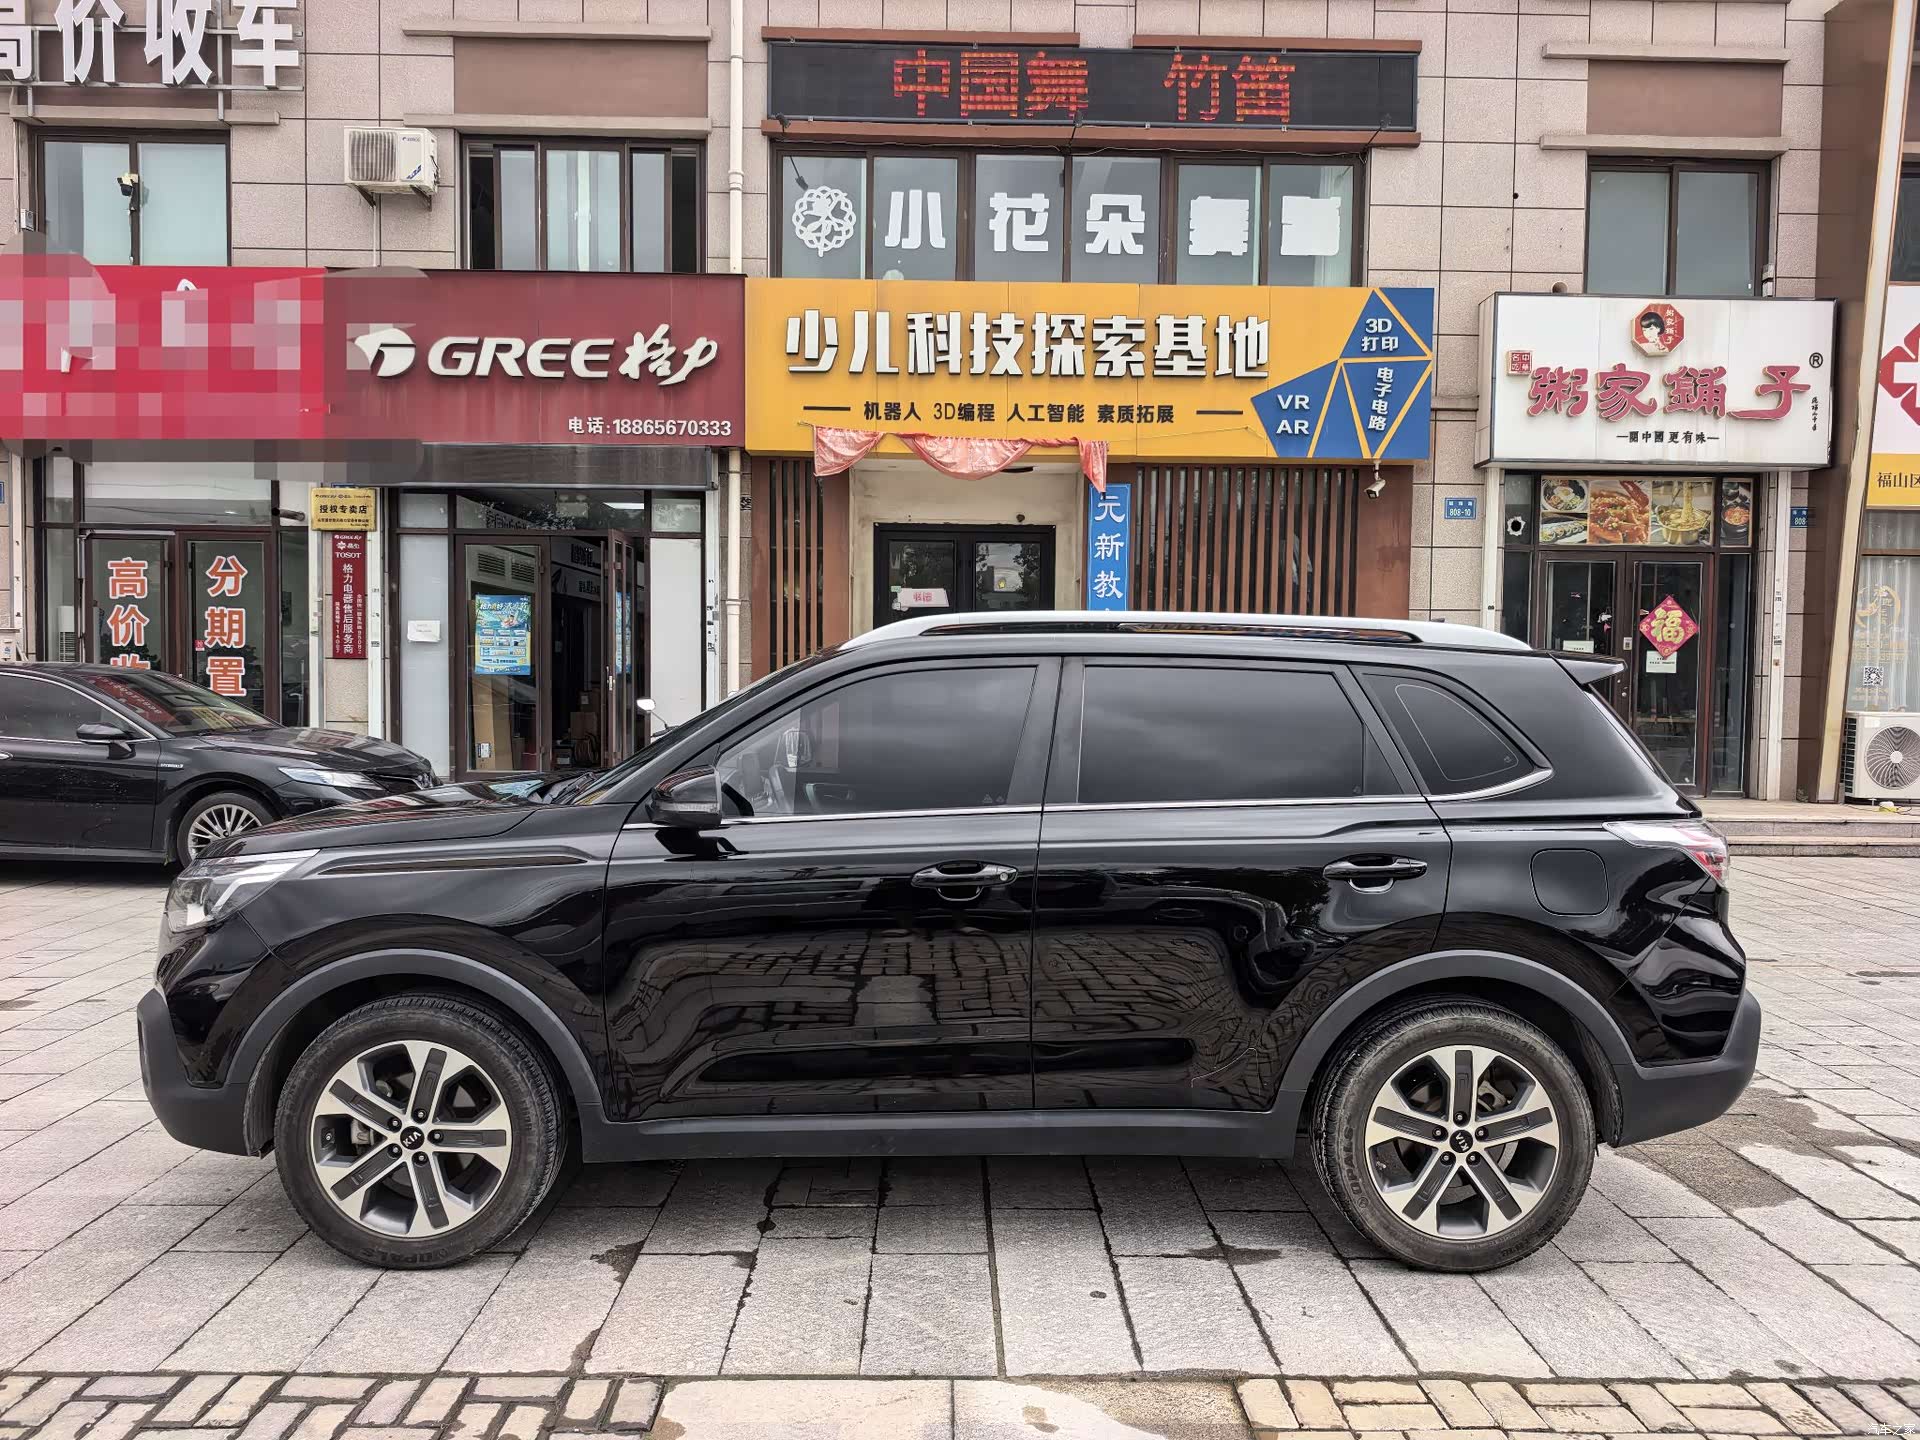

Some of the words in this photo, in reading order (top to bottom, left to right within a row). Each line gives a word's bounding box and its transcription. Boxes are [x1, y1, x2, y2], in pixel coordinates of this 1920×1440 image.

[892, 49, 1089, 119] 中国舞
[1163, 53, 1296, 123] 竹笛
[1365, 318, 1393, 334] 3D
[427, 336, 615, 379] GREE
[618, 323, 718, 386] 格力
[784, 308, 1270, 379] 少儿科技探索基地
[1361, 336, 1399, 352] 打印
[863, 400, 922, 422] 机器人
[933, 401, 996, 423] 3D编程
[1007, 403, 1086, 424] 人工智能
[1096, 404, 1175, 424] 素质拓展
[1276, 393, 1311, 411] VR
[1367, 367, 1394, 431] 电子电路
[568, 416, 732, 437] 电话:18865670333
[1276, 418, 1311, 436] AR
[319, 503, 367, 514] 授权专卖店
[334, 551, 362, 559] TOSOT
[1092, 495, 1126, 611] 元新教
[342, 563, 354, 655] 格力电器售后服务商
[204, 554, 248, 698] 分期置
[1650, 607, 1685, 644] 福
